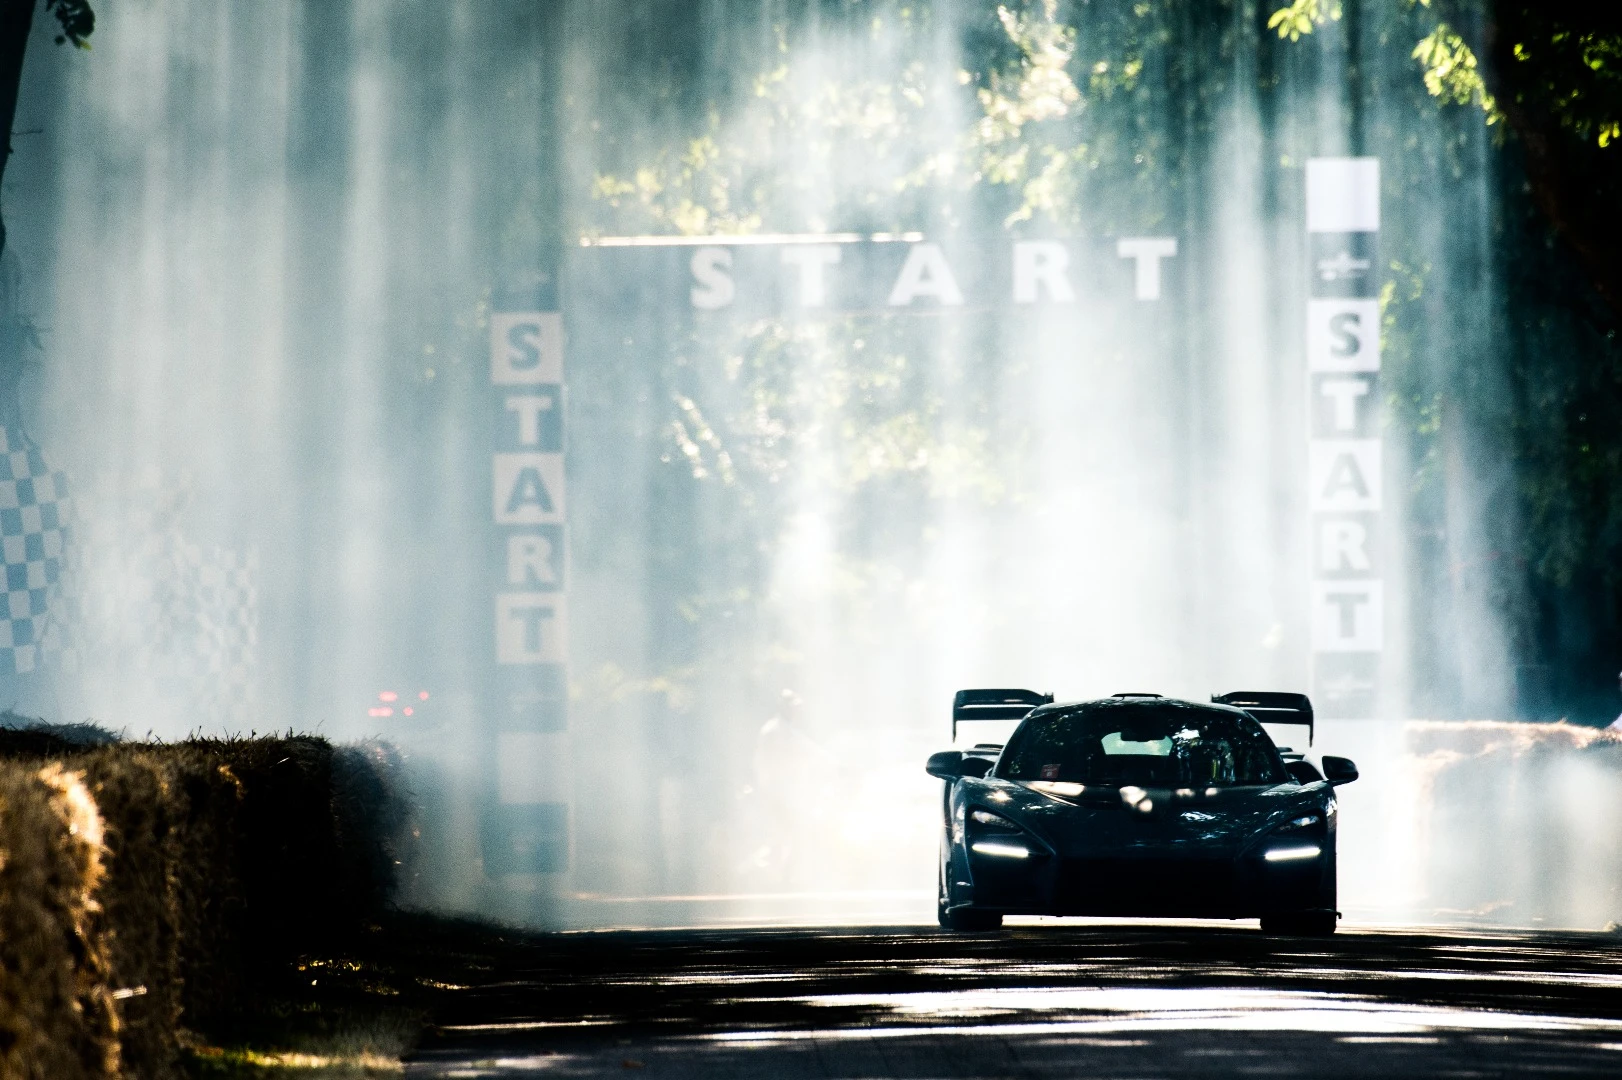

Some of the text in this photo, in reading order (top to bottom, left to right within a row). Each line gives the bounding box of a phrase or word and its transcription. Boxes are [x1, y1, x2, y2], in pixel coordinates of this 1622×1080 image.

[690, 237, 1178, 310] START
[506, 323, 556, 655] START
[1320, 311, 1371, 639] START
